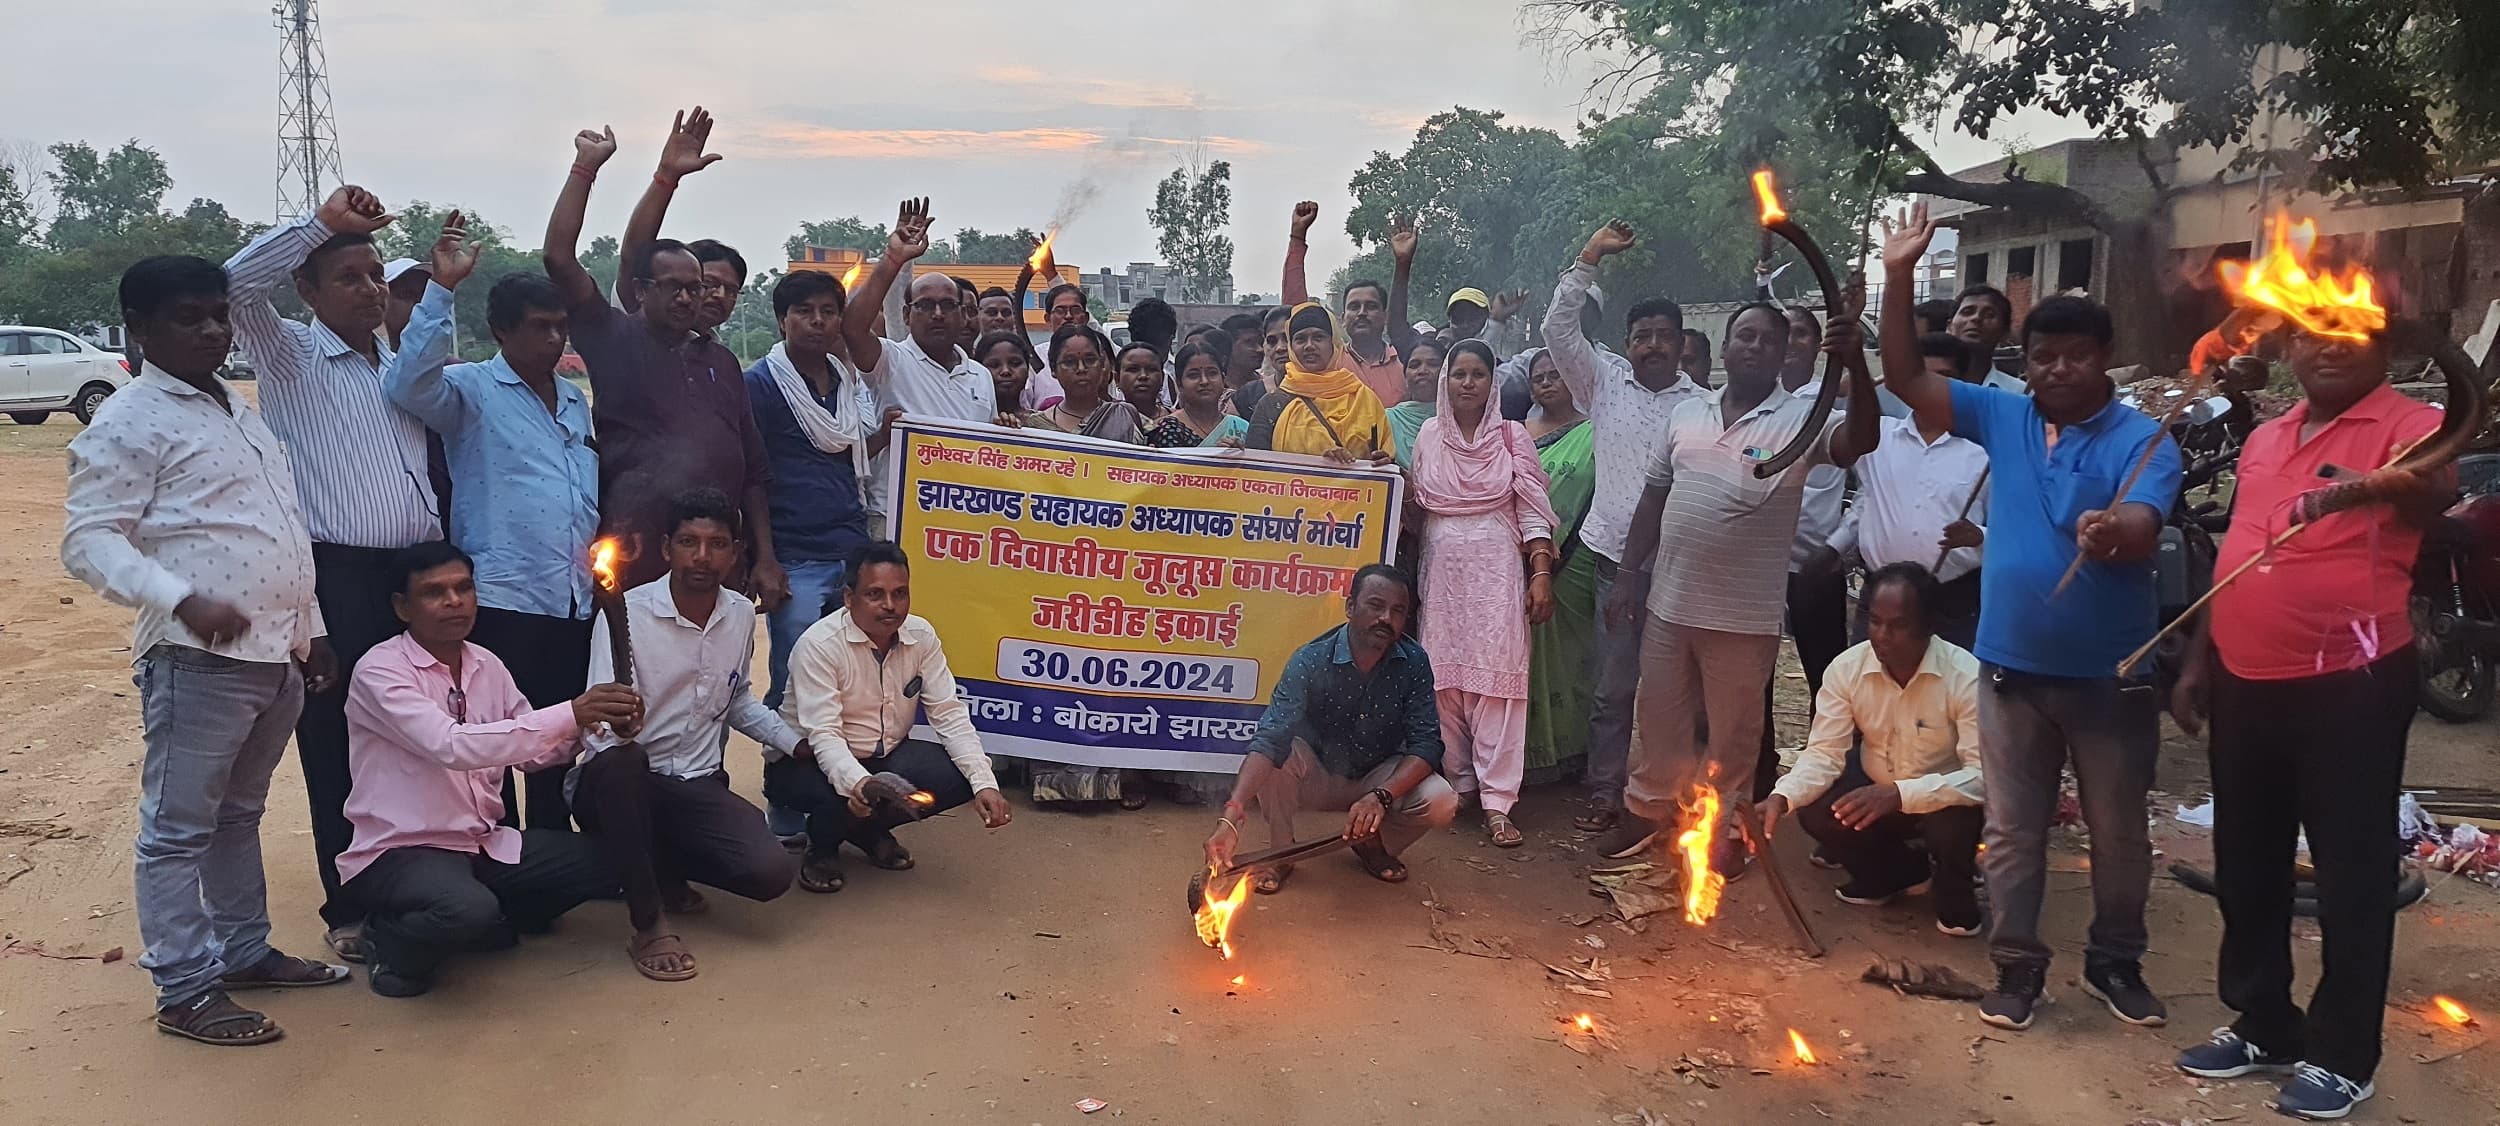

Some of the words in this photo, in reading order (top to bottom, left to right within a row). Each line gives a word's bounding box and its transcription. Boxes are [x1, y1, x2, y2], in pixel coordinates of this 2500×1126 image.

[917, 441, 973, 465] मुनेश्वर
[978, 447, 1009, 470] सिंह
[1013, 455, 1051, 474] अमर
[1054, 458, 1077, 478] रहे
[1107, 466, 1168, 485] सहायक
[1171, 473, 1237, 491] अध्यापक
[1241, 479, 1286, 496] एकता
[1290, 479, 1361, 502] जिन्दाबाद
[917, 480, 1025, 521] झारखण्ड
[1030, 492, 1128, 529] सहायक
[1130, 505, 1237, 538] अध्यापक
[1242, 506, 1304, 544] संघर्ष
[1306, 511, 1365, 549] मोर्चा
[924, 528, 984, 562] एक
[989, 527, 1128, 580] दिवासीय
[1133, 550, 1226, 598] जूलूस
[1231, 553, 1357, 598] कार्यक्रम
[1033, 593, 1150, 637] जरीडीह
[1154, 602, 1242, 648] इकाई
[1022, 648, 1234, 693] 30.06.2024
[1053, 700, 1160, 735] बोकारो
[1168, 715, 1259, 741] झारख
